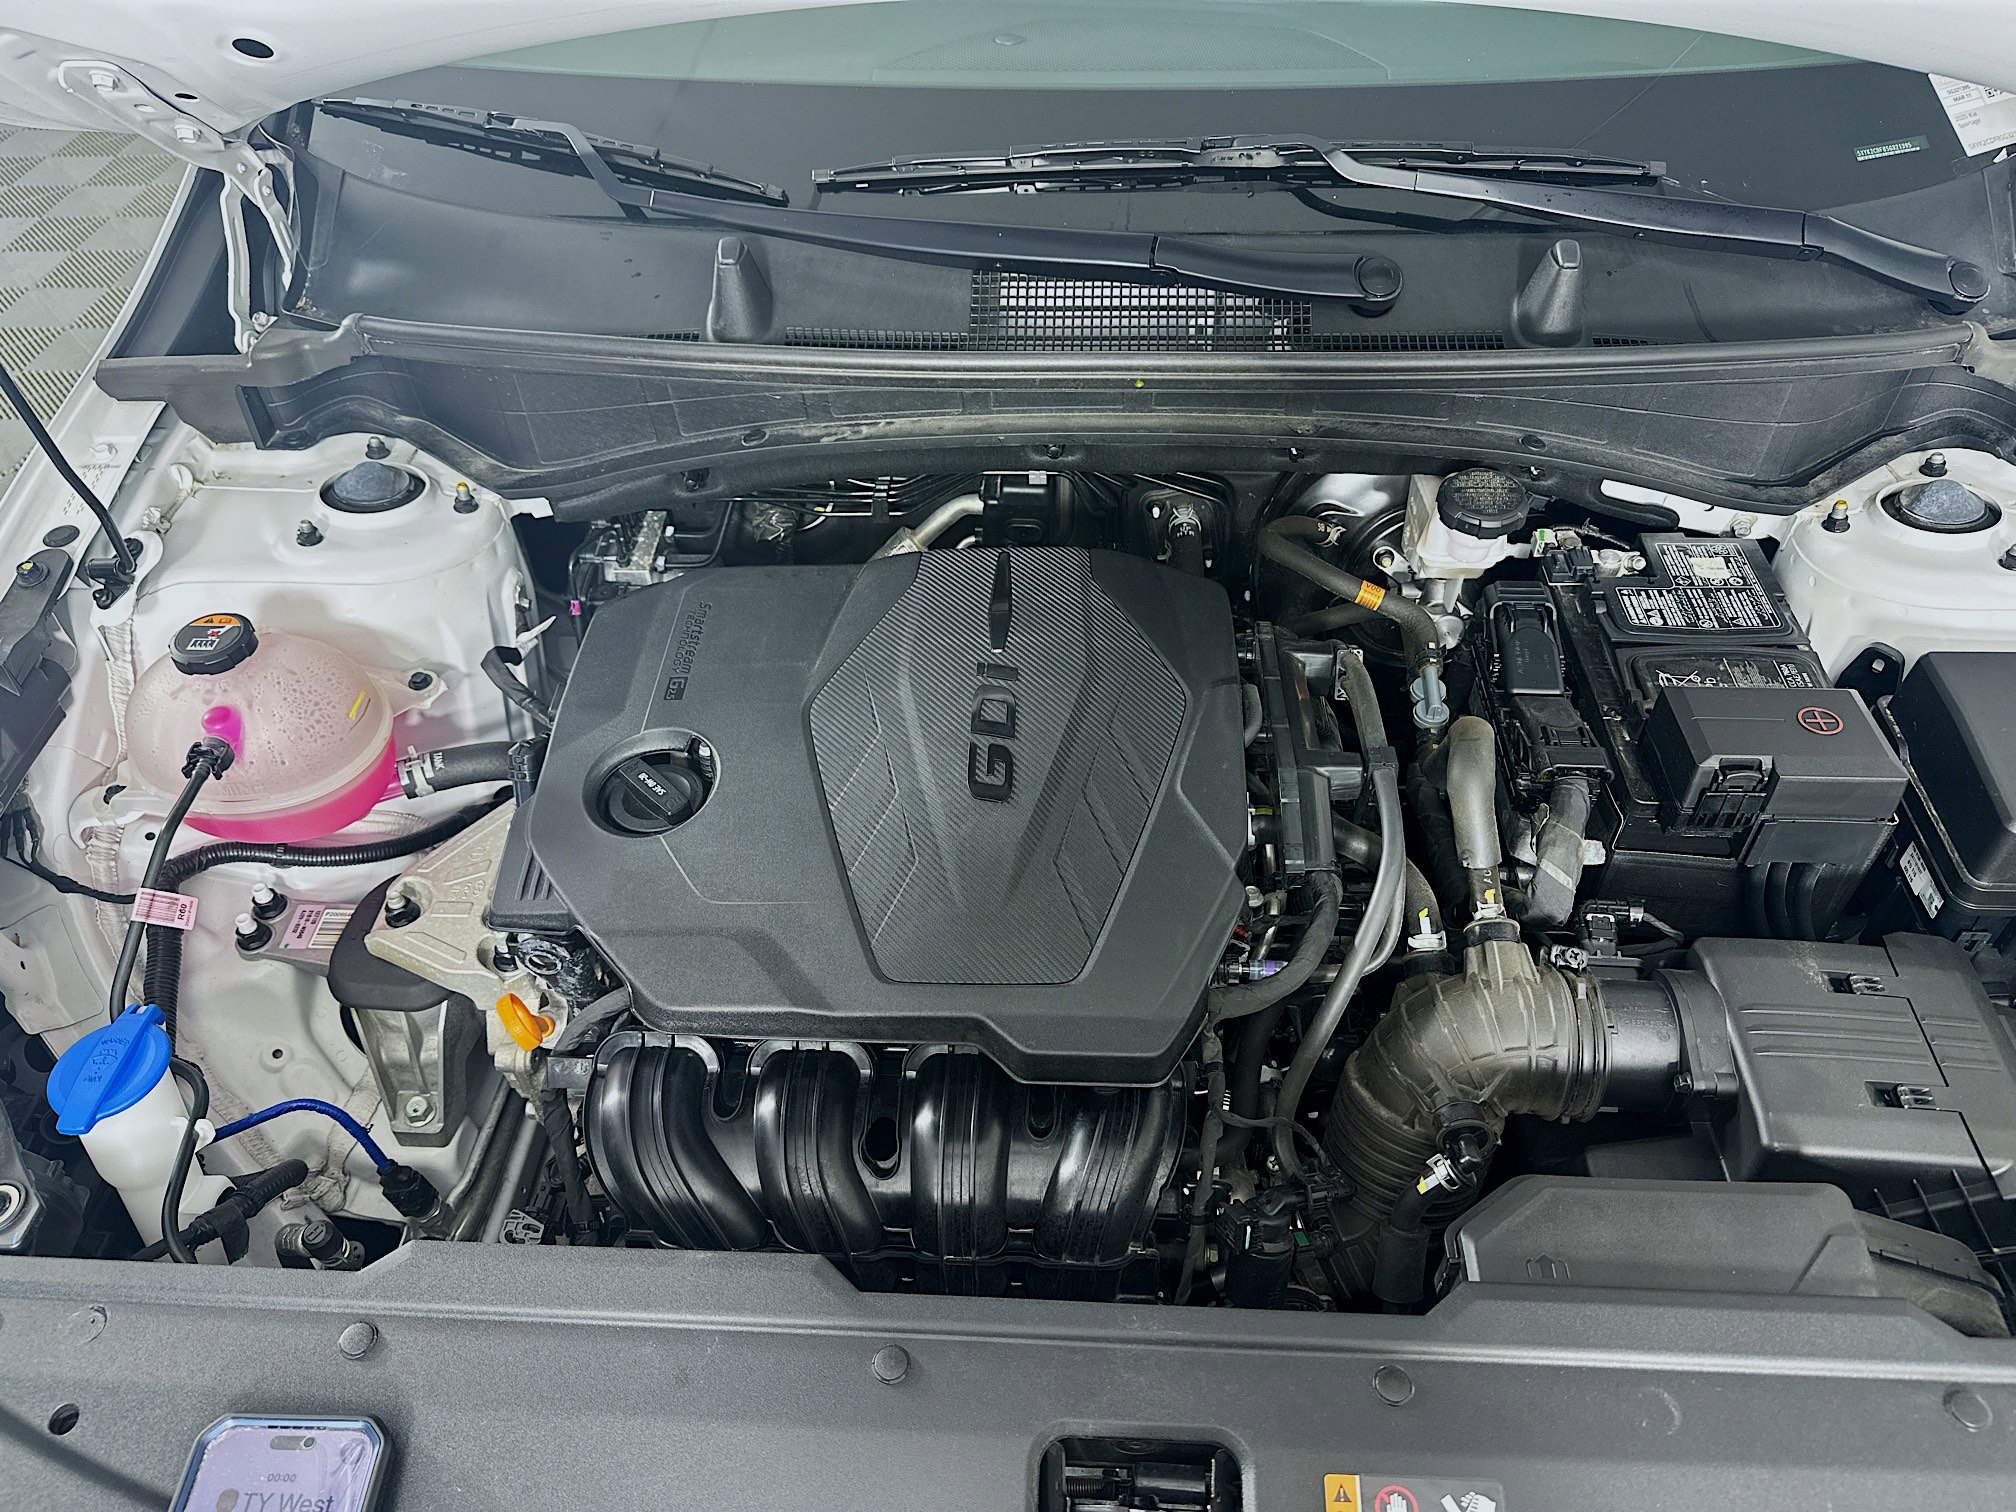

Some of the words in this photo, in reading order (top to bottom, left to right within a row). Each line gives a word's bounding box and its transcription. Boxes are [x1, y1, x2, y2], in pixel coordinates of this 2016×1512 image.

[1953, 94, 1965, 102] MAR
[1957, 118, 1981, 129] Sportage
[672, 608, 698, 674] TECHNOLOGY
[681, 601, 712, 674] Smartstream
[267, 1473, 297, 1483] 00:00
[243, 1492, 275, 1512] TY
[279, 1492, 334, 1512] West
